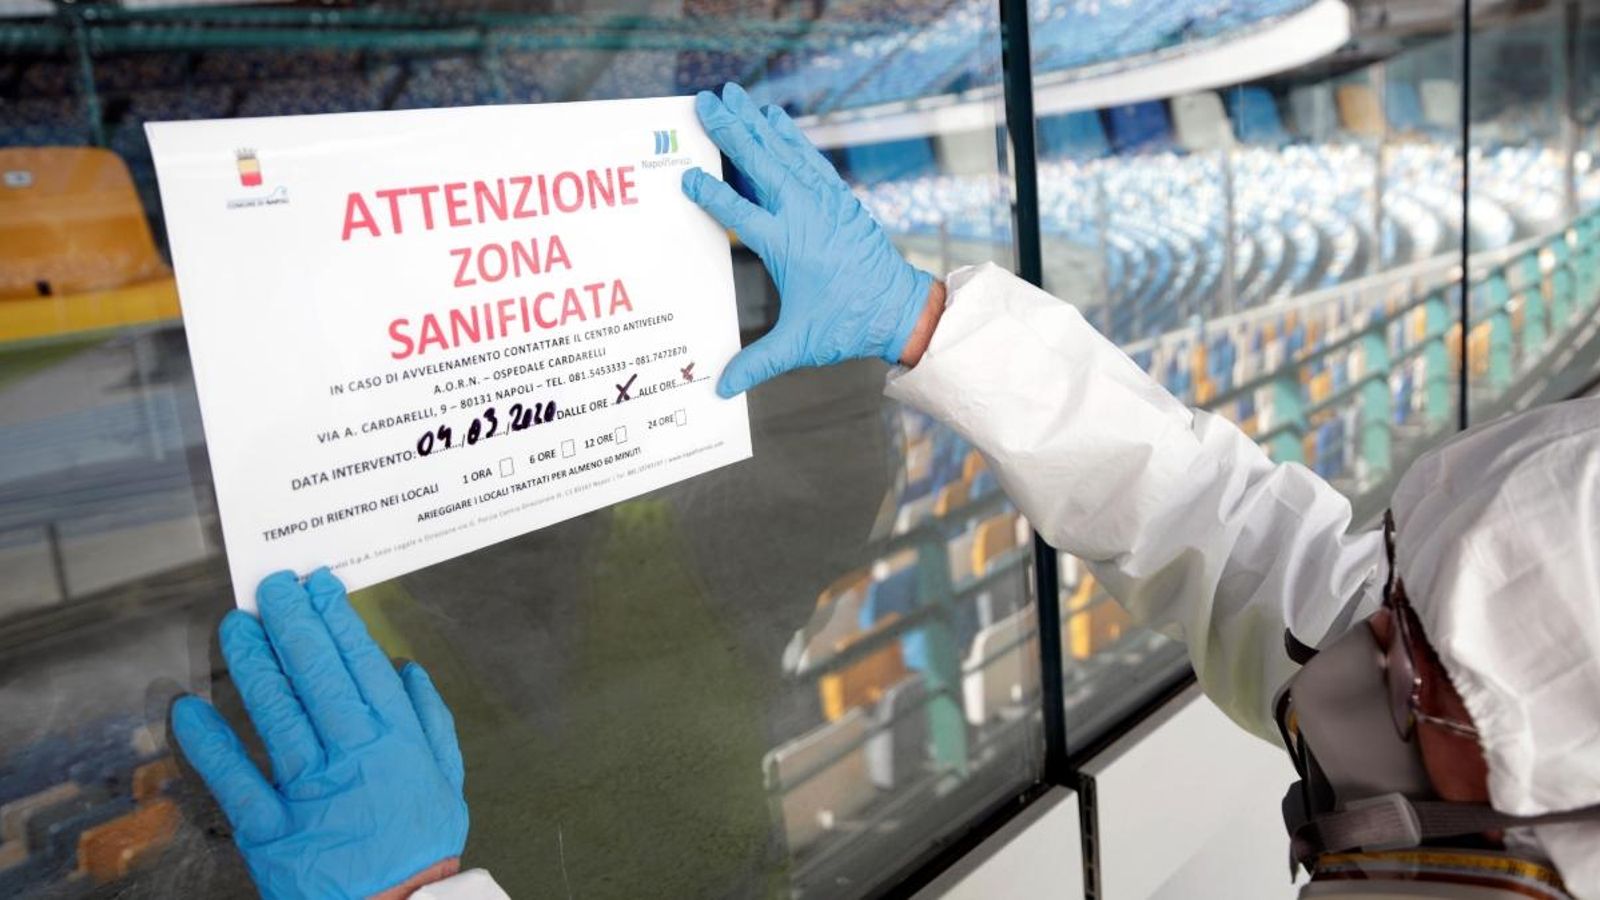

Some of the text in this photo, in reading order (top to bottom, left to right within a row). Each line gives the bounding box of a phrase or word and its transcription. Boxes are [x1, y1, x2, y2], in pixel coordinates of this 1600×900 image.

[341, 166, 638, 241] ATTENZIONE
[449, 235, 571, 288] ZONA
[388, 278, 633, 360] SANIFICATA
[330, 313, 675, 396] IN CASO DI AVVELENAMENTO CONTATTARE IL CENTRO ANTIVELENO
[434, 375, 480, 395] A.O.R.N.
[493, 361, 546, 381] OSPEDALE
[548, 347, 607, 368] CARDARELLI
[317, 428, 341, 444] VIA
[345, 427, 357, 437] A.
[361, 407, 438, 434] CARDARELLI,
[440, 404, 447, 414] 9
[460, 392, 492, 410] 80131
[495, 382, 534, 401] NAPOLI
[545, 376, 566, 388] TEL.
[568, 361, 627, 382] 081.5453333
[556, 398, 608, 420] DALLE ORE
[638, 383, 658, 398] ALLE
[584, 432, 614, 449] 12 ORE
[647, 414, 675, 430] 24 ORE
[291, 450, 417, 492] DATA INTERVENTO:
[463, 467, 493, 484] 1 ORA
[529, 449, 557, 464] 6 ORE
[417, 496, 472, 522] ARIEGGIARE
[479, 487, 509, 503] LOCALI
[511, 474, 550, 494] TRATTATI
[551, 470, 568, 481] PER
[568, 459, 603, 476] ALMENO
[604, 456, 614, 465] 60
[615, 446, 642, 462] MINUTI
[262, 483, 440, 543] TEMPO DI RIENTRO NEI LOCALI
